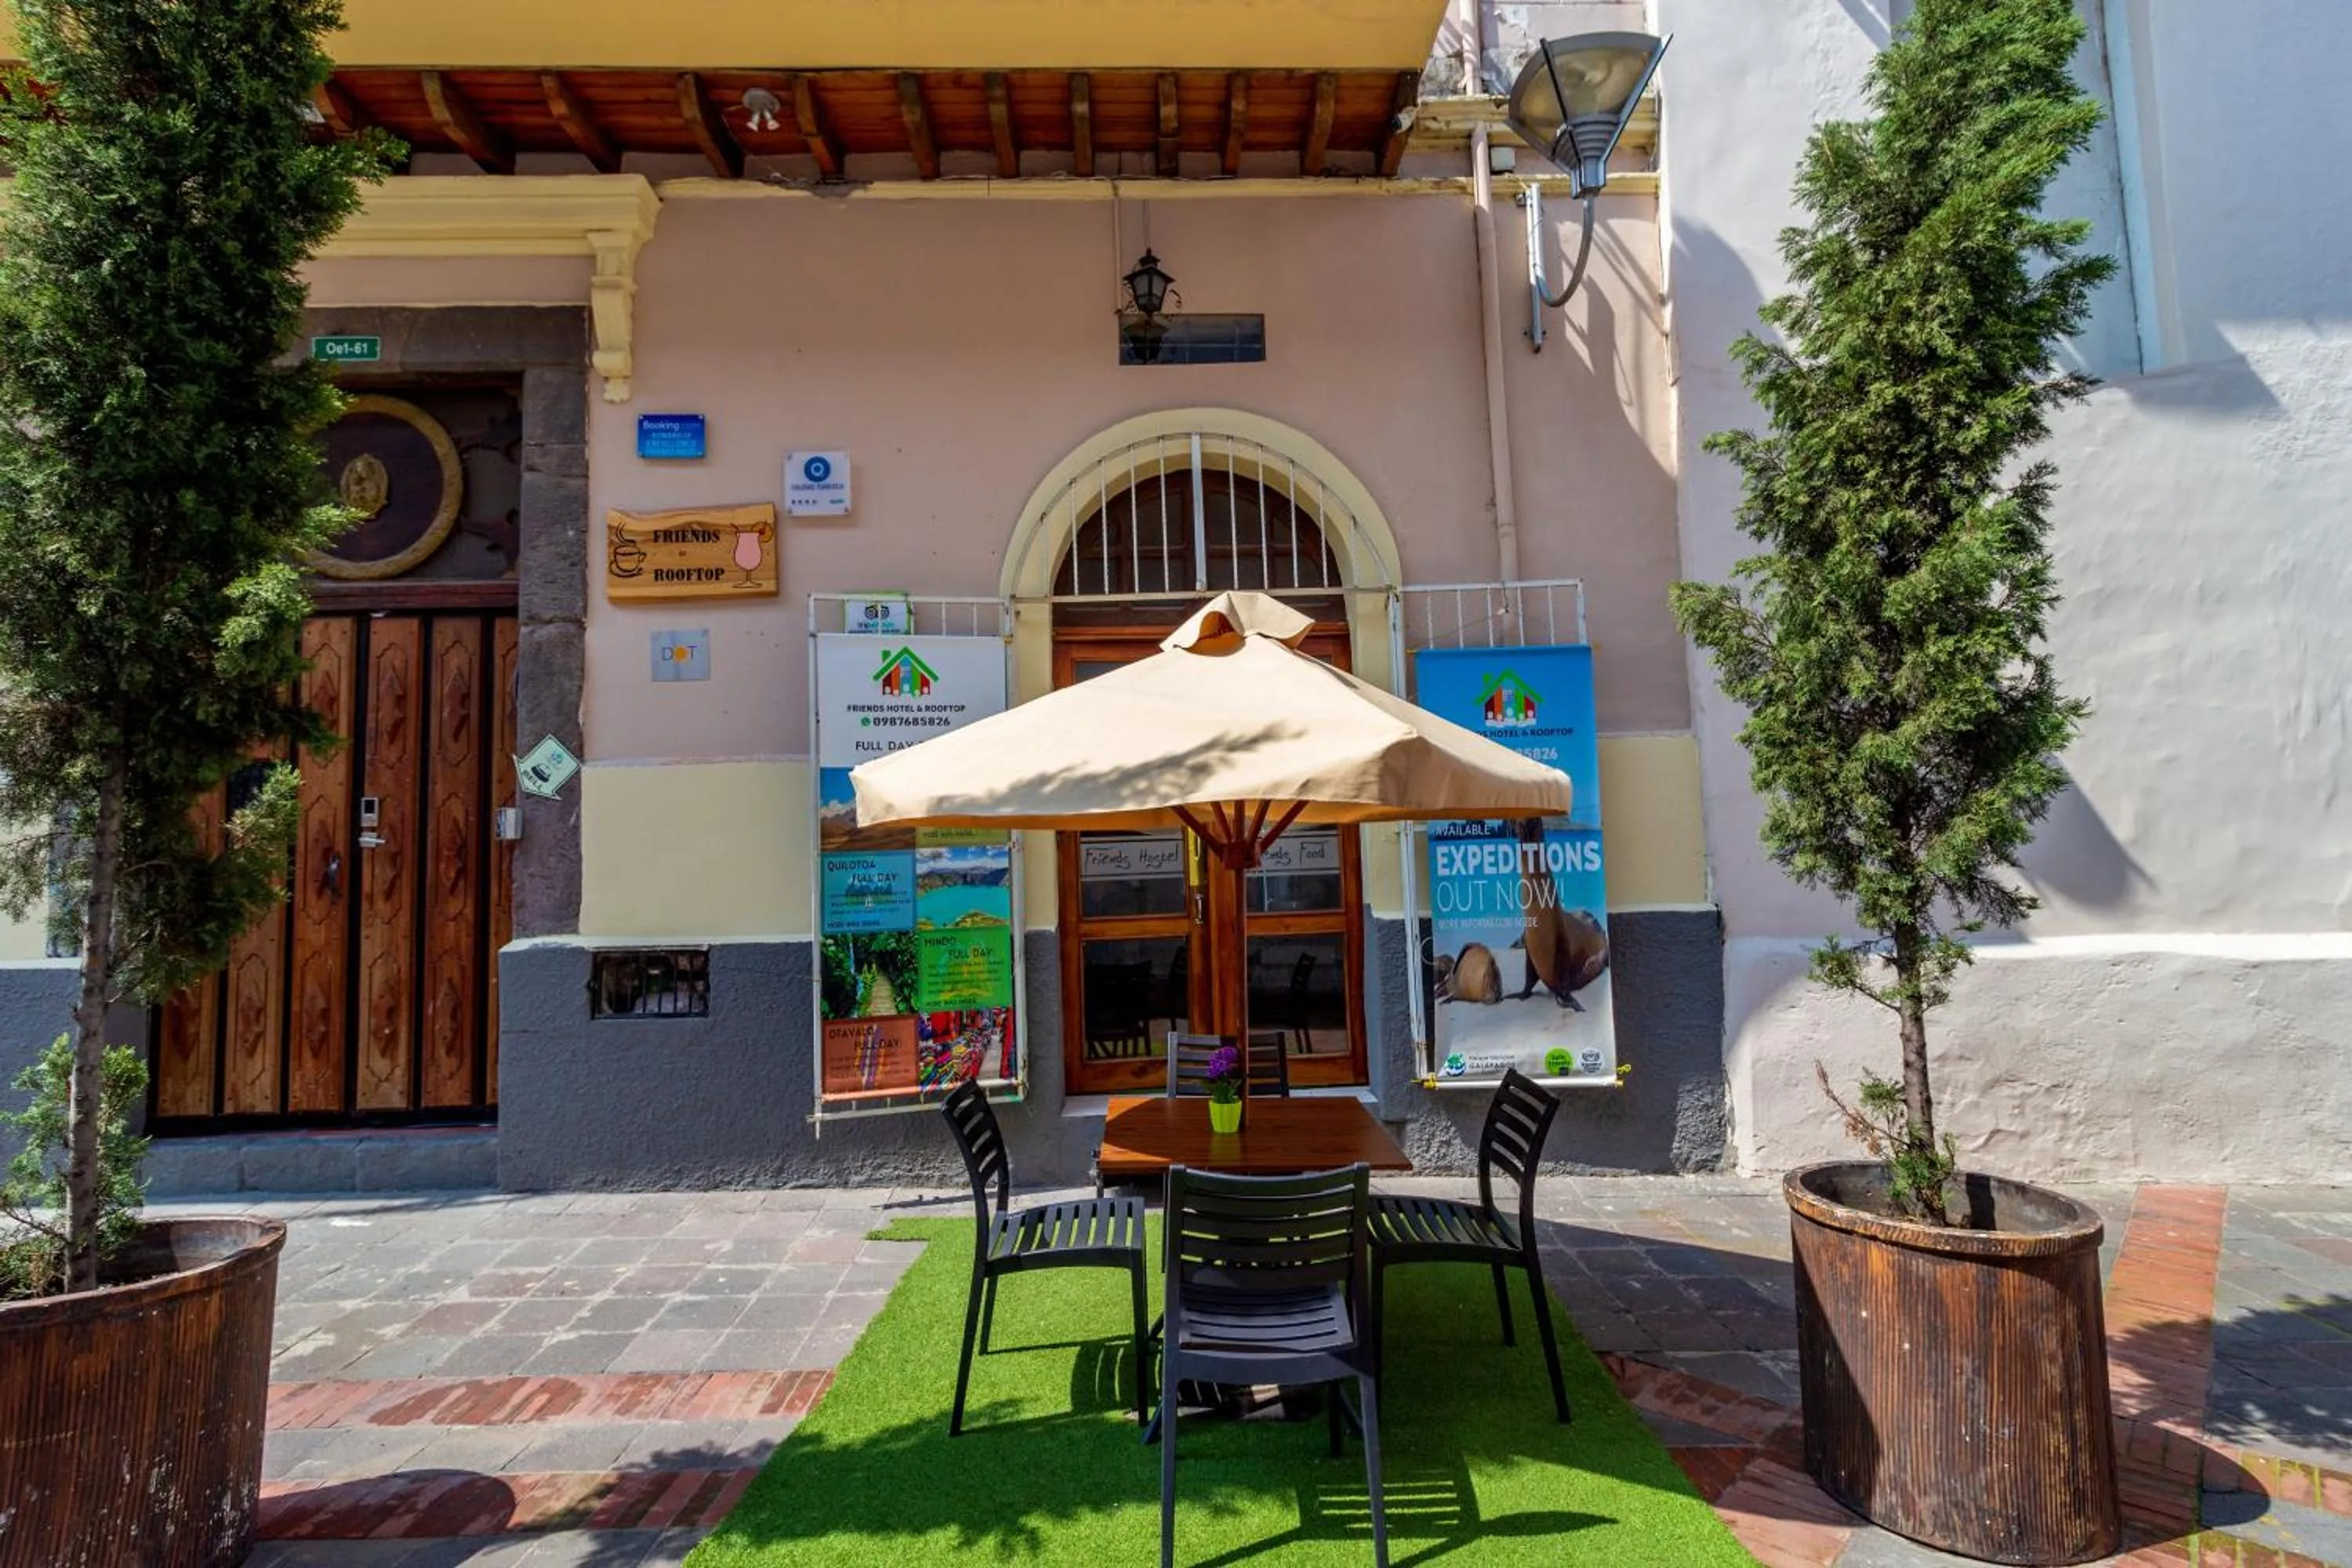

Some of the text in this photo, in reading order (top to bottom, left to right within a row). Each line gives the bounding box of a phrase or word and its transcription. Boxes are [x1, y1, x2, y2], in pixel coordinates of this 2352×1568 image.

[652, 528, 721, 543] FRIENDS
[654, 568, 725, 582] ROOFTOP
[855, 741, 884, 751] FULL
[1436, 840, 1602, 877] EXPEDITIONS
[852, 871, 898, 883] FULL DAY
[1436, 877, 1565, 913] OUT NOW!
